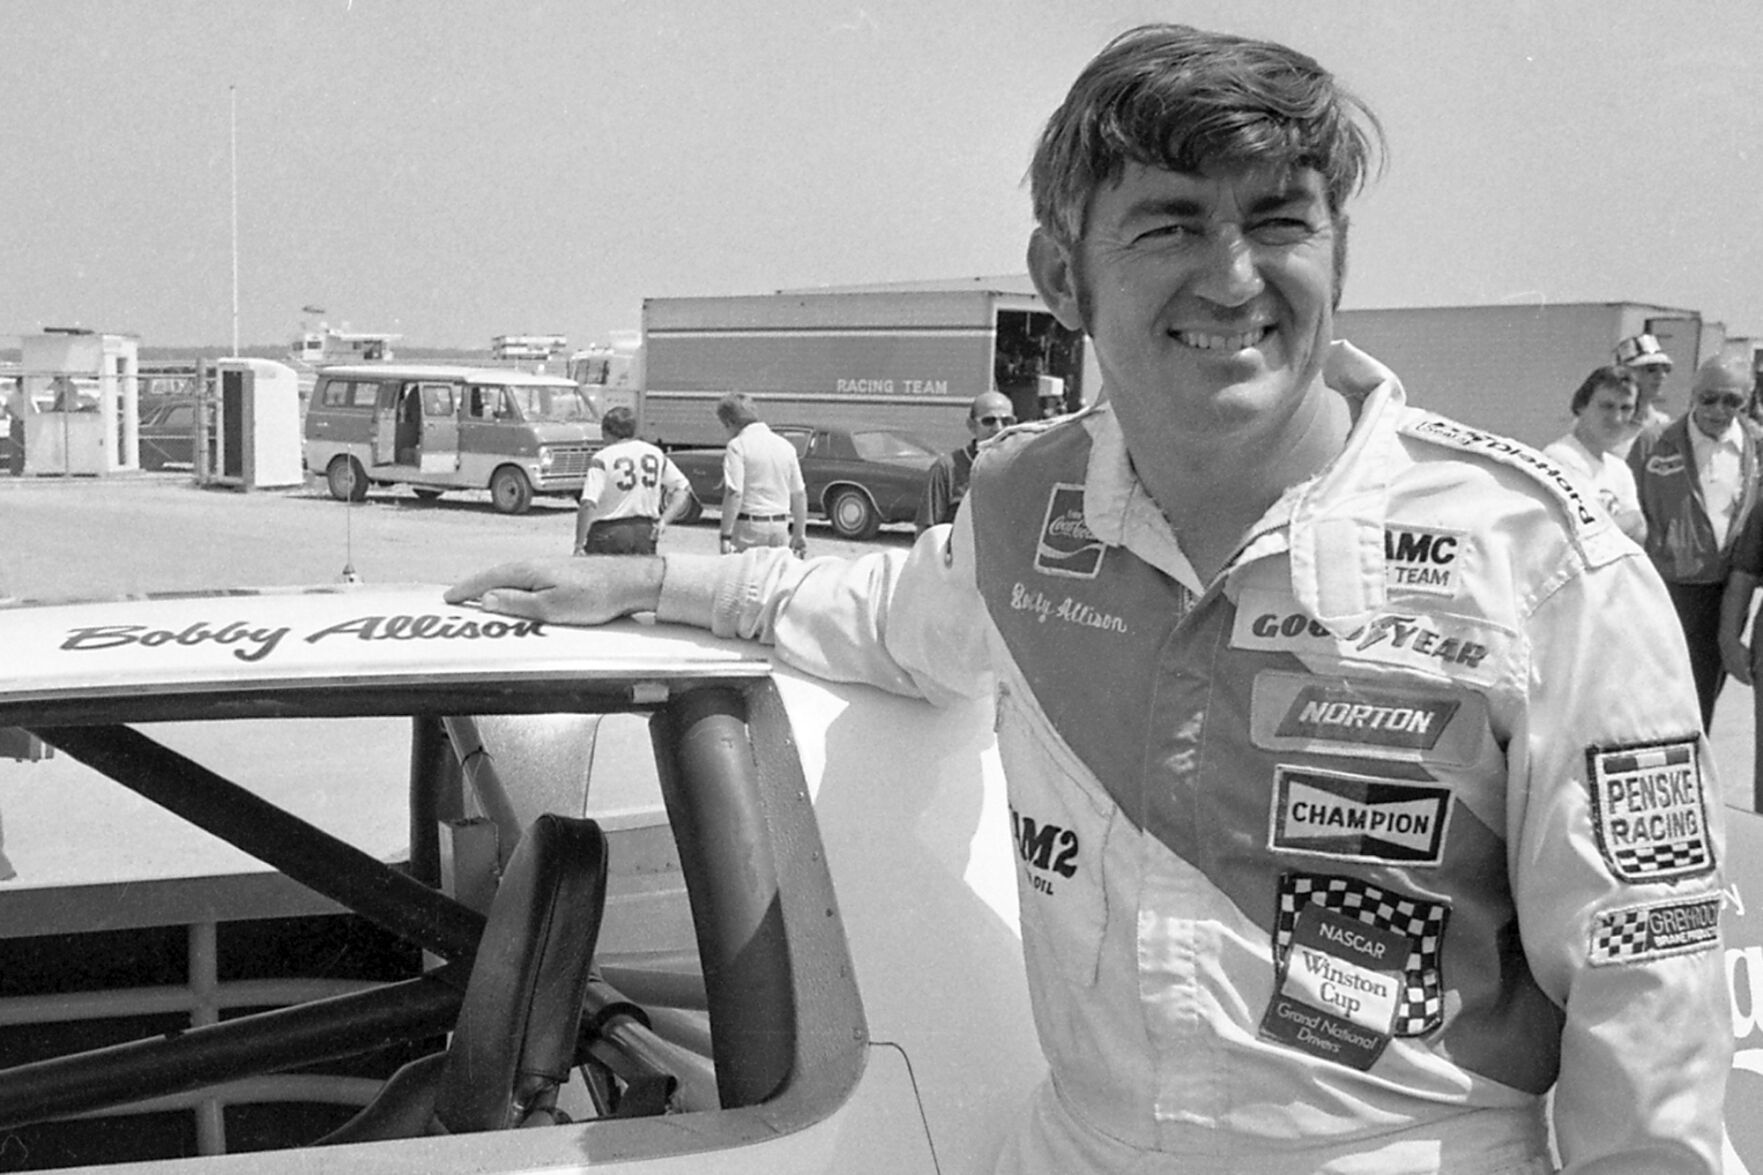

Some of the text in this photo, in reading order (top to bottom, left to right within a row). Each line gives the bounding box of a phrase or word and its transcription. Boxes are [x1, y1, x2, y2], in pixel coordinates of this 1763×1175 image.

[837, 378, 948, 395] RACING TEAM
[613, 453, 660, 492] 39
[1395, 567, 1450, 587] TEAM
[1056, 598, 1128, 633] Allison
[59, 615, 548, 662] Bobby Allison
[1252, 613, 1489, 669] GOOYEAR
[1299, 701, 1436, 734] NORTON
[1607, 769, 1695, 815] PENSKE
[1292, 802, 1430, 835] CHAMPION
[1611, 809, 1699, 846] RACING
[1033, 876, 1054, 896] OIL
[1319, 922, 1386, 959] NASCAR
[1302, 950, 1388, 998] Winston
[1320, 982, 1361, 1019] Cup
[1277, 1002, 1379, 1050] Grand National
[1297, 1027, 1342, 1053] Drivers
